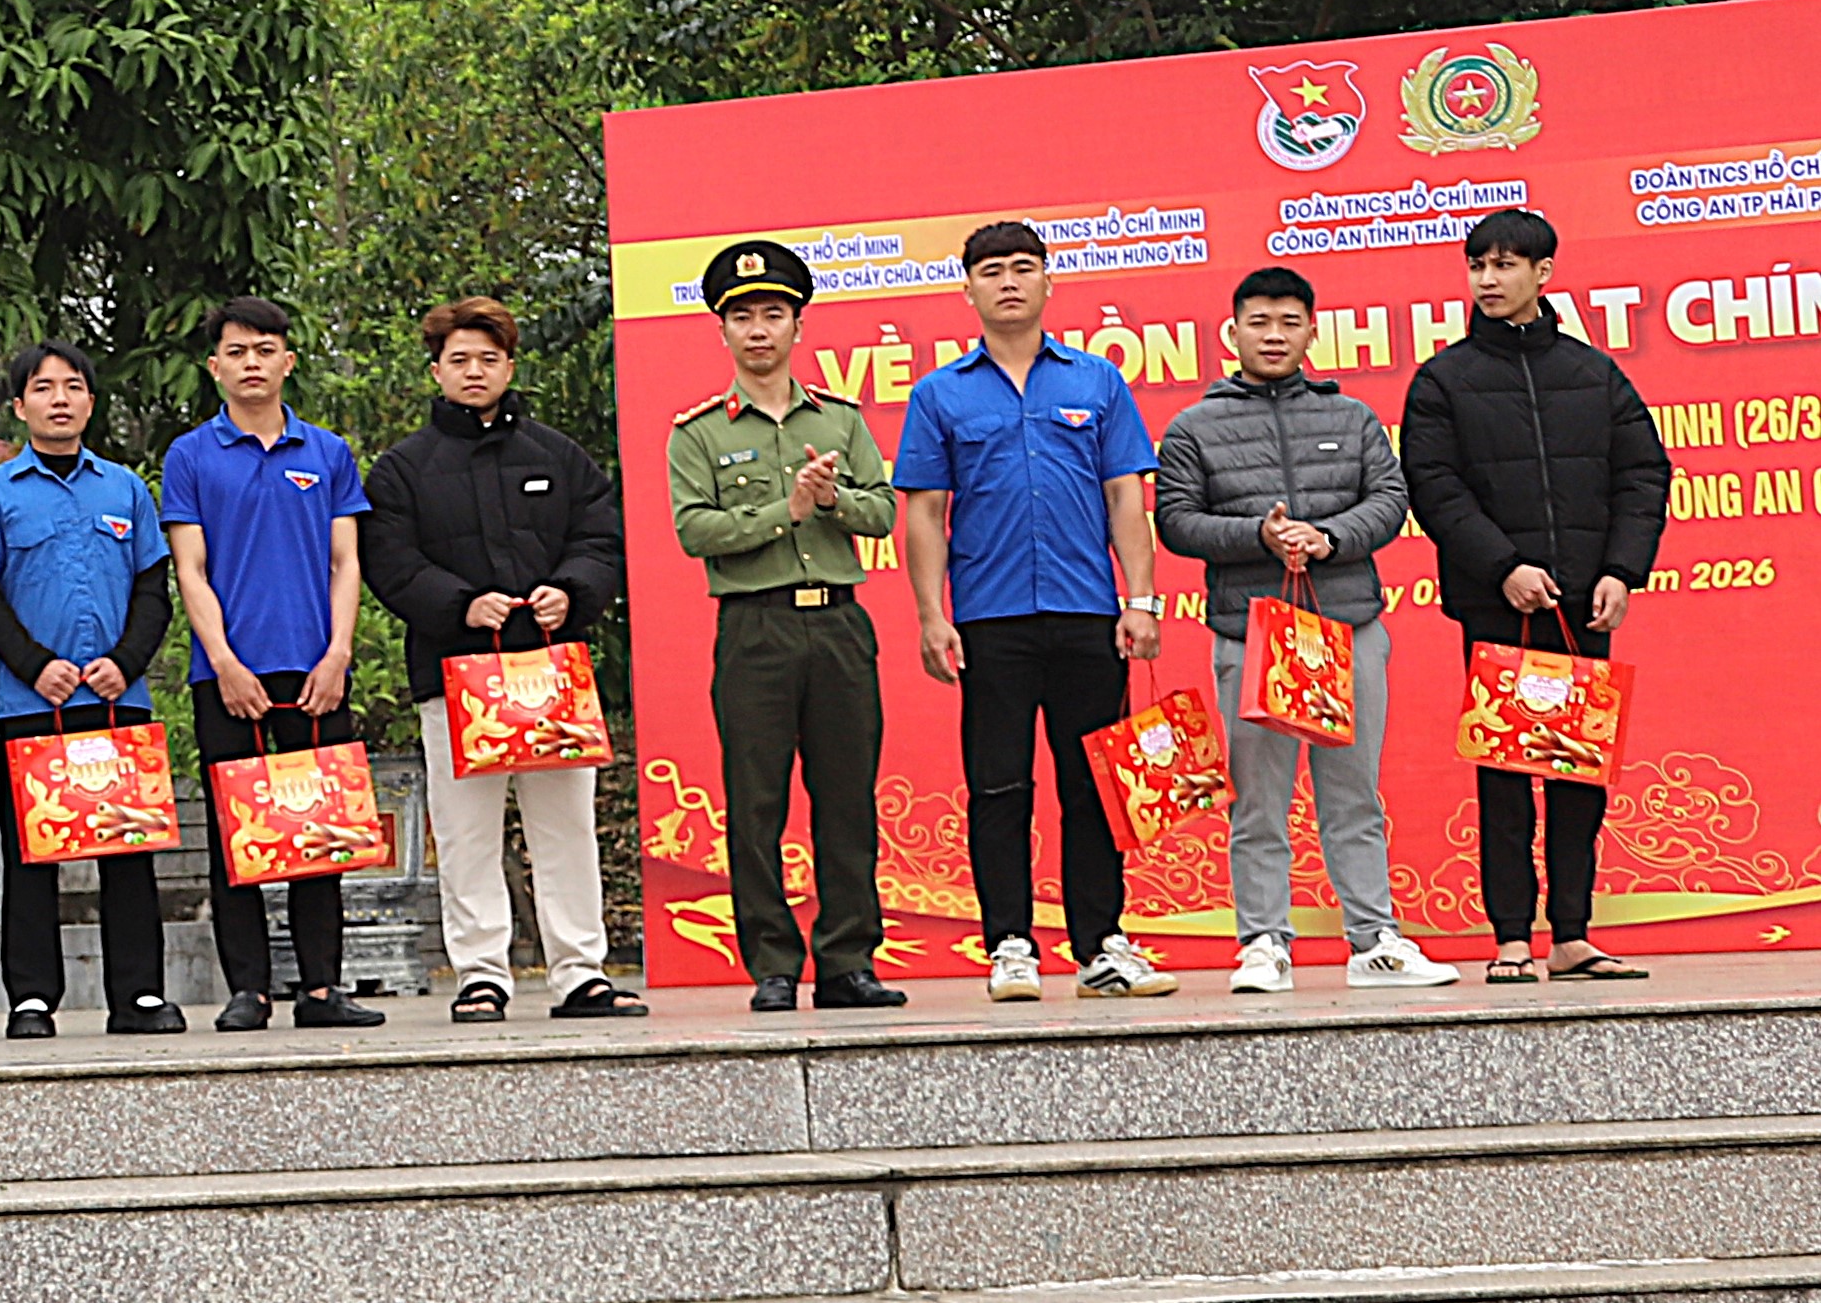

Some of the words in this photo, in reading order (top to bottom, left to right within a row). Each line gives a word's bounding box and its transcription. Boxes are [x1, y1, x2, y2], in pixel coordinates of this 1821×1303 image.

[1634, 166, 1692, 191] ĐOÀN
[1698, 165, 1748, 185] TNCS
[1755, 153, 1784, 179] HỒ
[1285, 193, 1339, 220] ĐOÀN
[1346, 195, 1393, 216] TNCS
[1399, 185, 1427, 210] HỒ
[1434, 185, 1468, 208] CHÍ
[1474, 185, 1524, 204] MINH
[1640, 197, 1702, 222] CÔNG
[1709, 198, 1736, 217] AN
[1742, 195, 1764, 214] TP
[1770, 186, 1804, 211] HẢI
[1051, 221, 1092, 240] TNCS
[1097, 210, 1121, 235] HỒ
[1126, 212, 1155, 233] CHÍ
[1159, 211, 1202, 231] MINH
[1272, 228, 1329, 252] CÔNG
[1337, 228, 1362, 247] AN
[1367, 221, 1409, 245] TỈNH
[1415, 217, 1458, 241] THÁI
[813, 234, 833, 261] HỒ
[837, 236, 861, 259] CHÍ
[865, 238, 900, 257] MINH
[1056, 252, 1078, 270] AN
[1082, 244, 1118, 268] TỈNH
[1123, 243, 1170, 265] HƯNG
[1174, 238, 1204, 260] YÊN
[843, 265, 881, 288] CHÁY
[884, 264, 922, 286] CHỮA
[815, 323, 914, 405] VỀ
[1647, 402, 1724, 449] INH
[1666, 467, 1743, 521] ÔNG
[1752, 468, 1803, 516] AN
[1689, 557, 1776, 590] 2026
